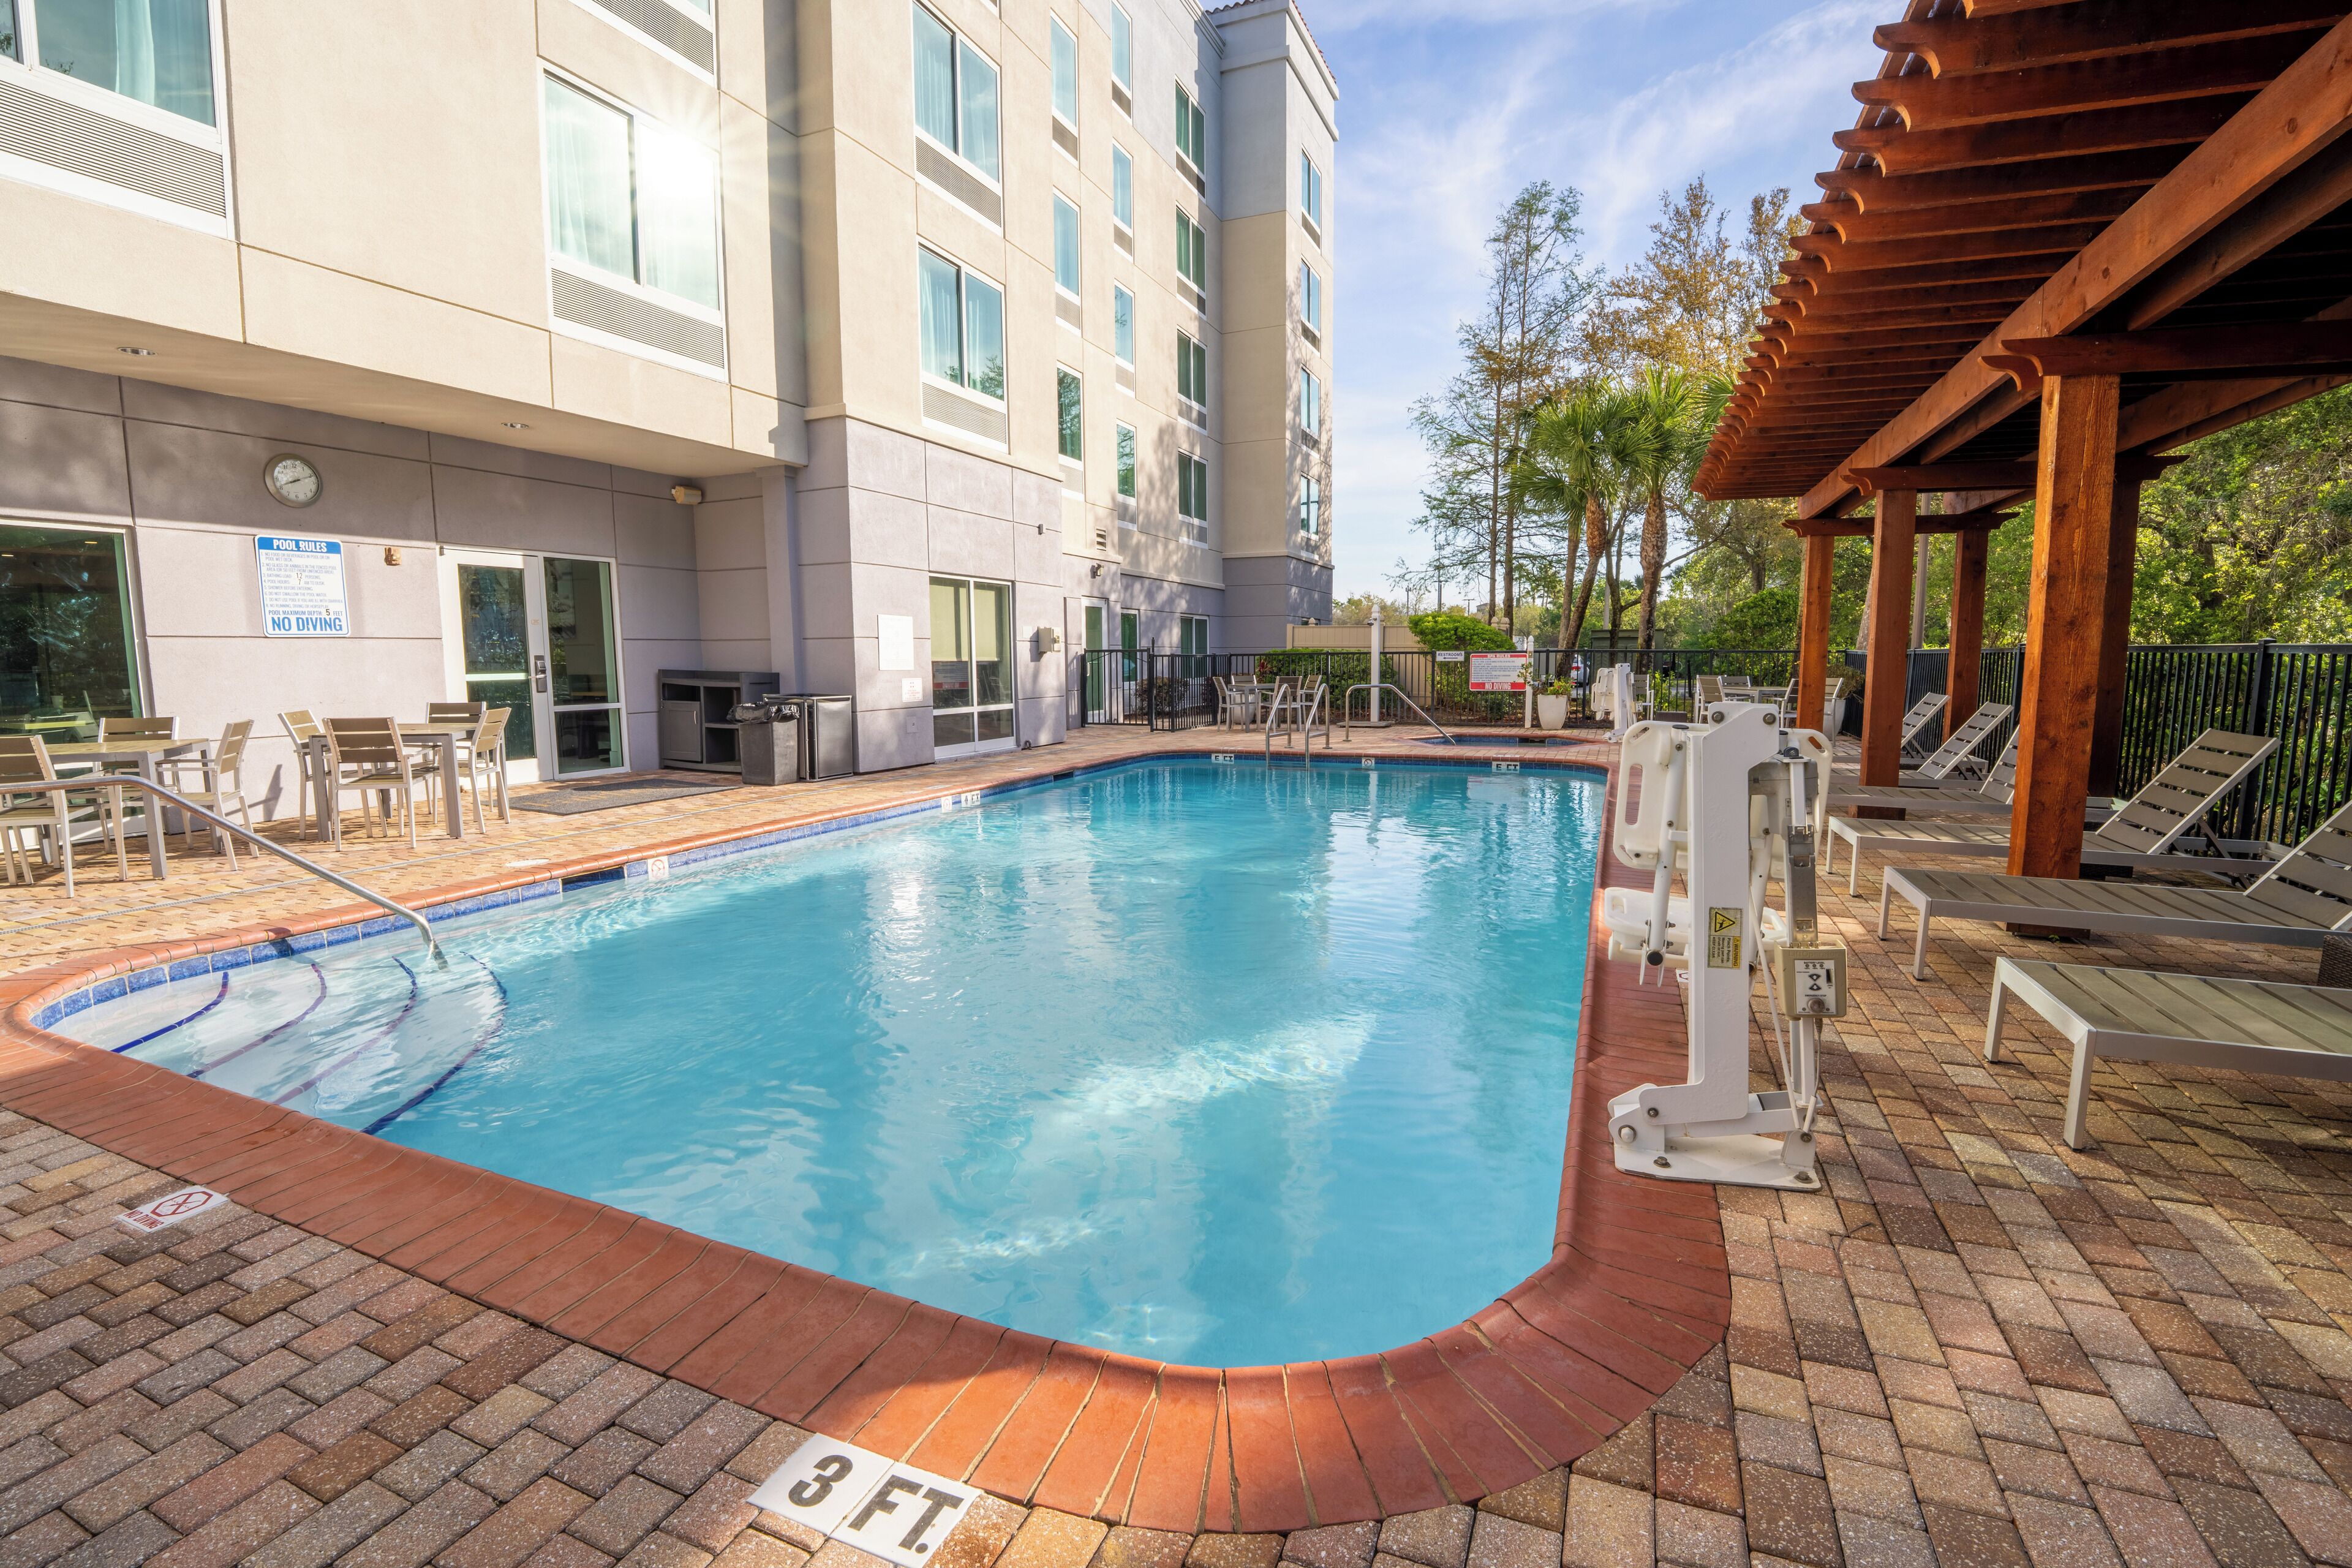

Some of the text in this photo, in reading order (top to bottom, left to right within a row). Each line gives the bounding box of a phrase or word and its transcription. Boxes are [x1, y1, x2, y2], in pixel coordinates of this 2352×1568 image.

[273, 539, 327, 552] POOL RULES
[271, 617, 342, 631] NO DIVING
[123, 1209, 164, 1229] NO DIVING
[788, 1454, 965, 1554] 3 FT.
